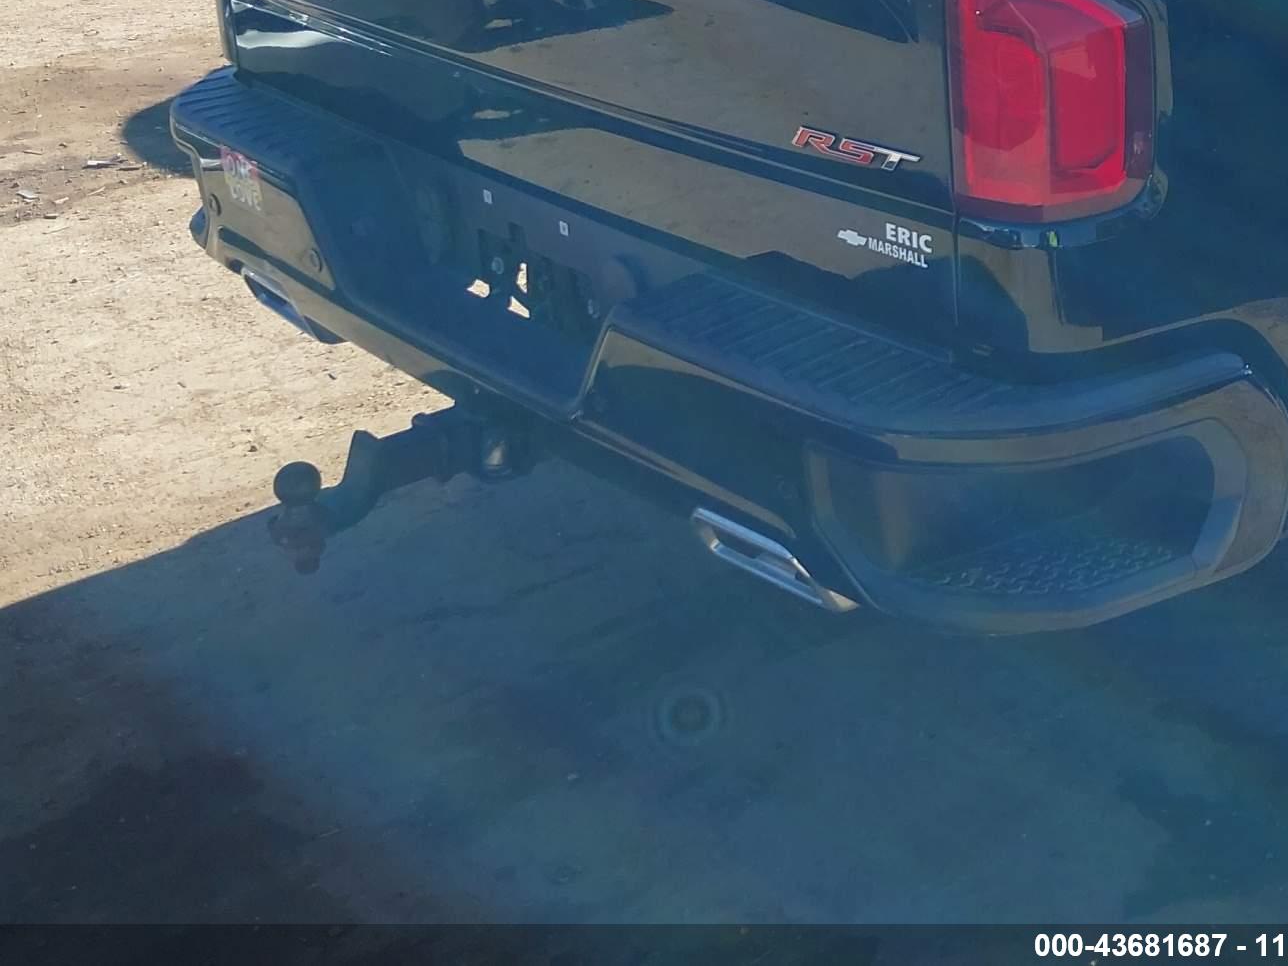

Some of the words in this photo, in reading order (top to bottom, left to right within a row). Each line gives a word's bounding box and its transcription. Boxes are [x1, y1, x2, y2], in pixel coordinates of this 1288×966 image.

[792, 127, 921, 172] RST
[868, 237, 930, 269] MARSHALL
[885, 222, 933, 254] ERIC
